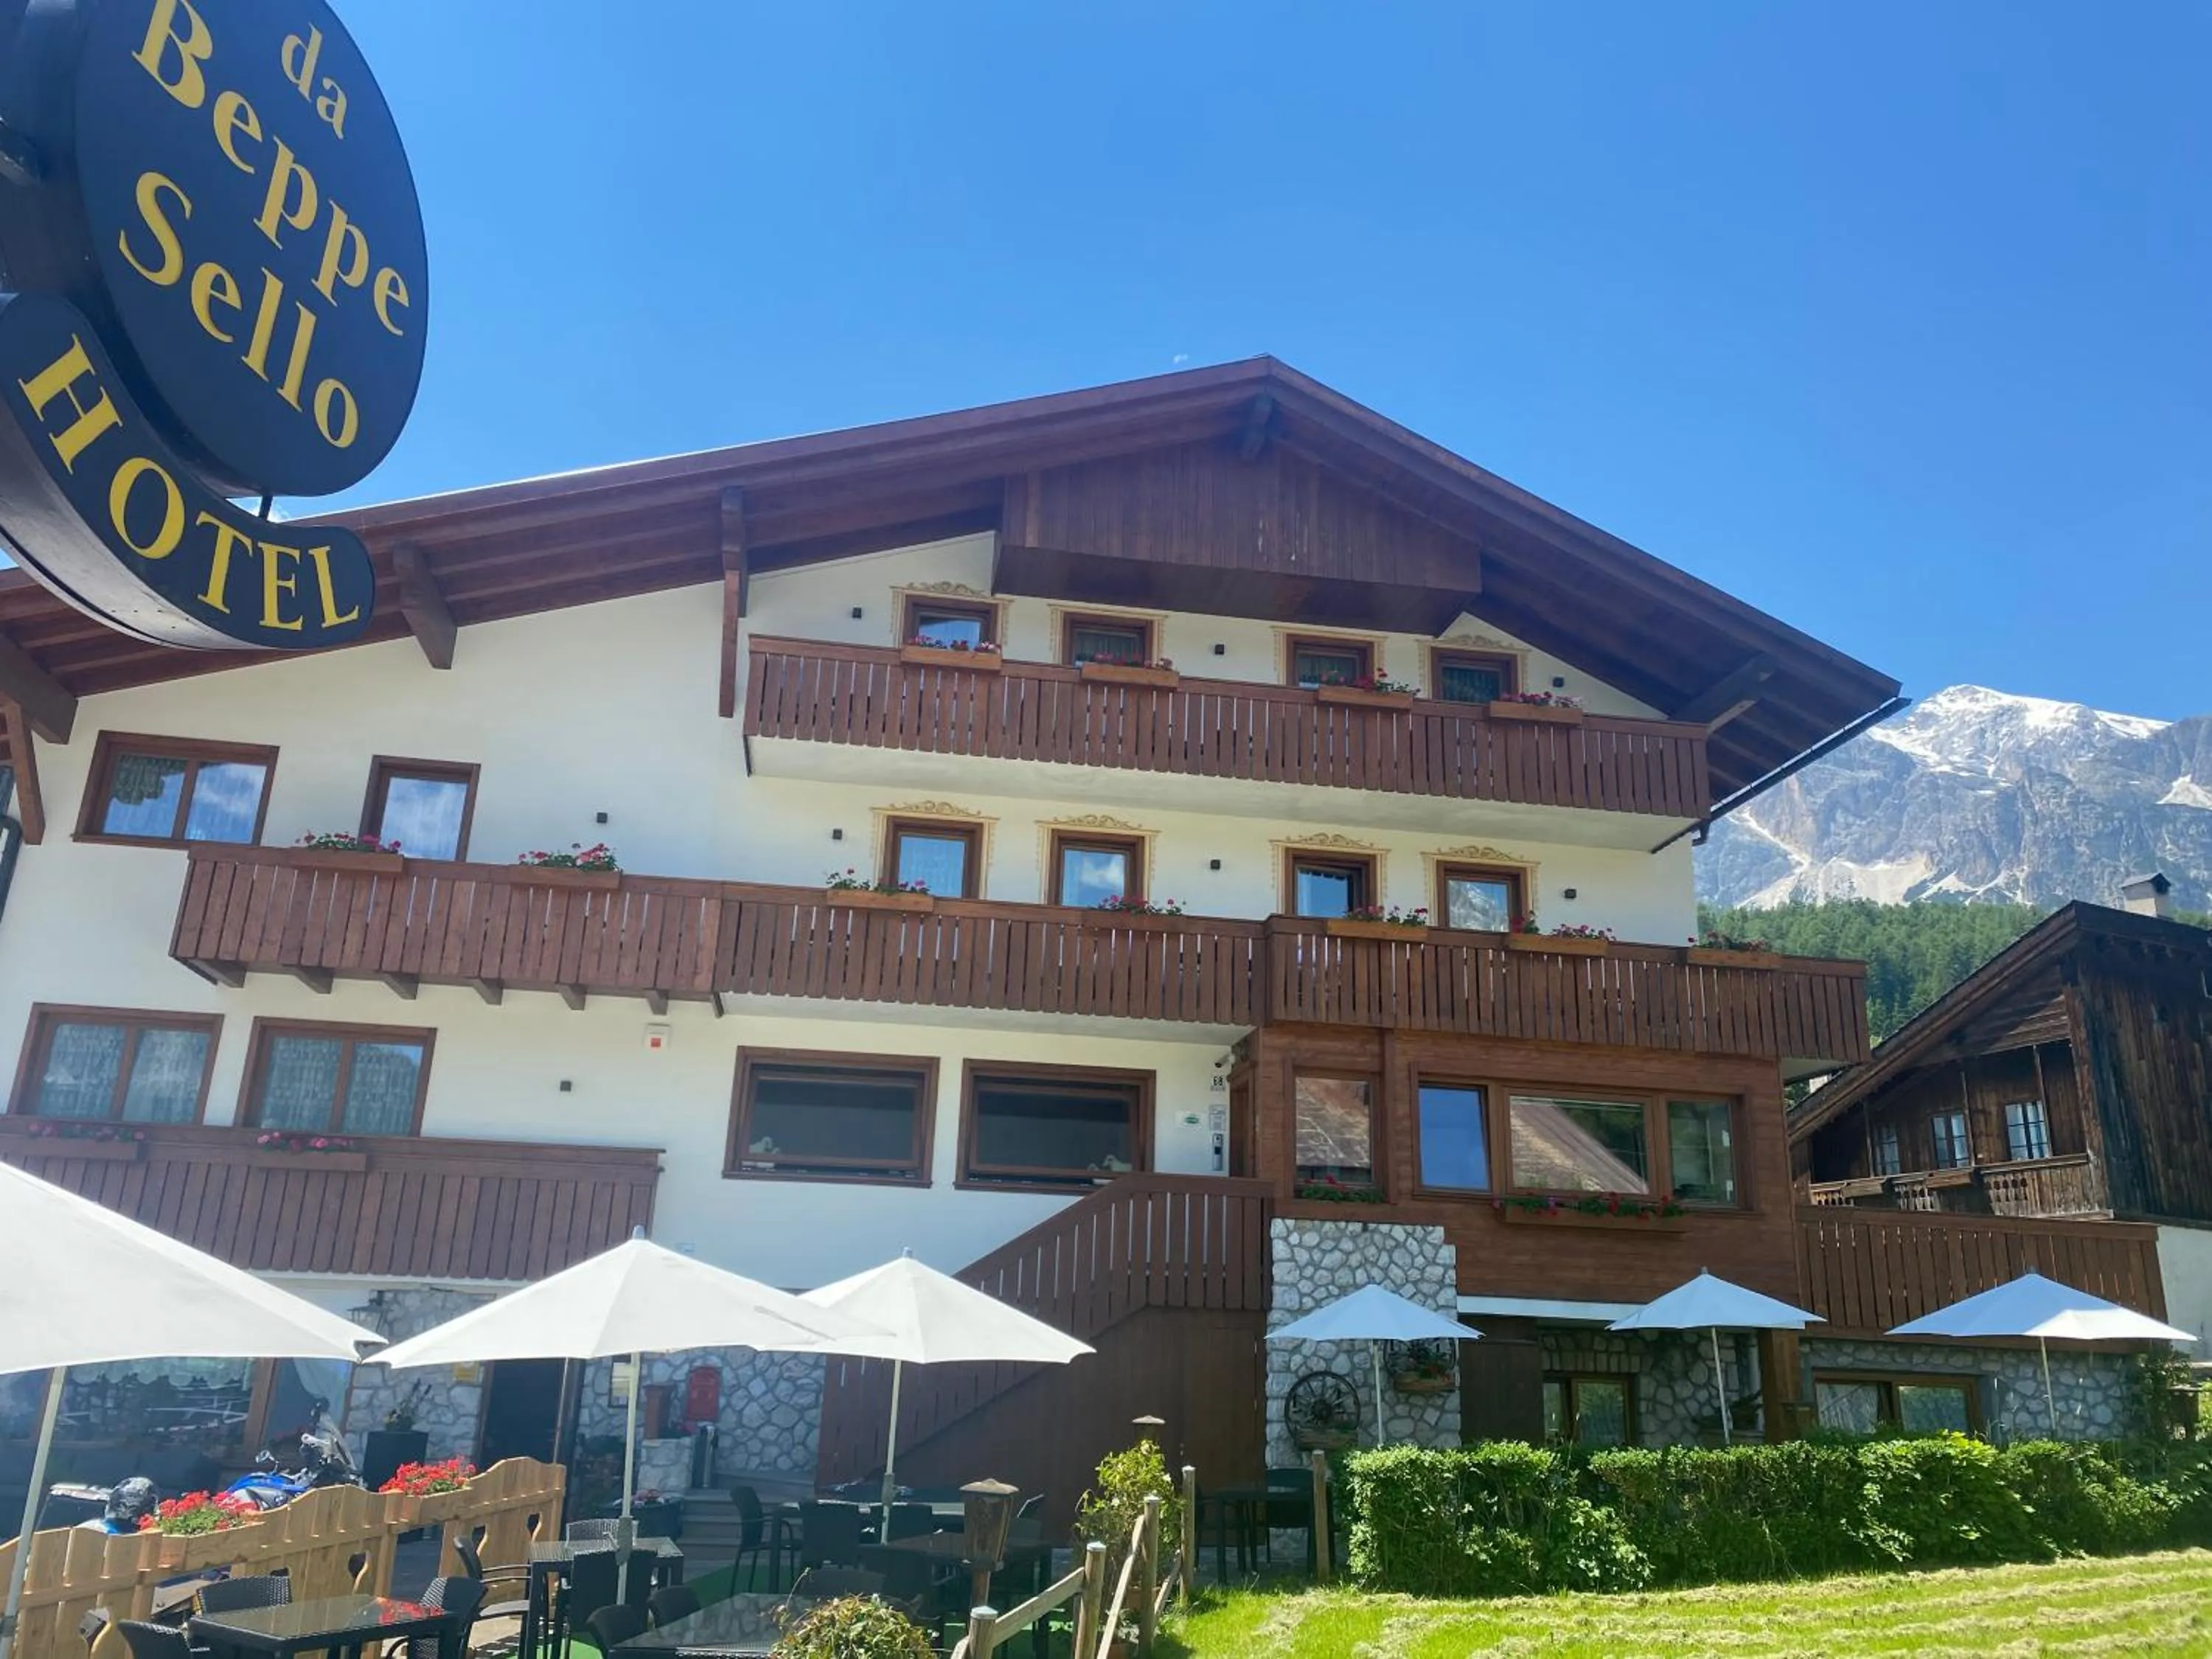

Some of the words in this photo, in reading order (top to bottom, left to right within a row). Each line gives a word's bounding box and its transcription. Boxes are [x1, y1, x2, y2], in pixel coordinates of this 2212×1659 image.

[131, 0, 410, 337] Beppe
[281, 22, 347, 140] da
[118, 171, 359, 448] Sello
[18, 333, 360, 632] HOTEL
